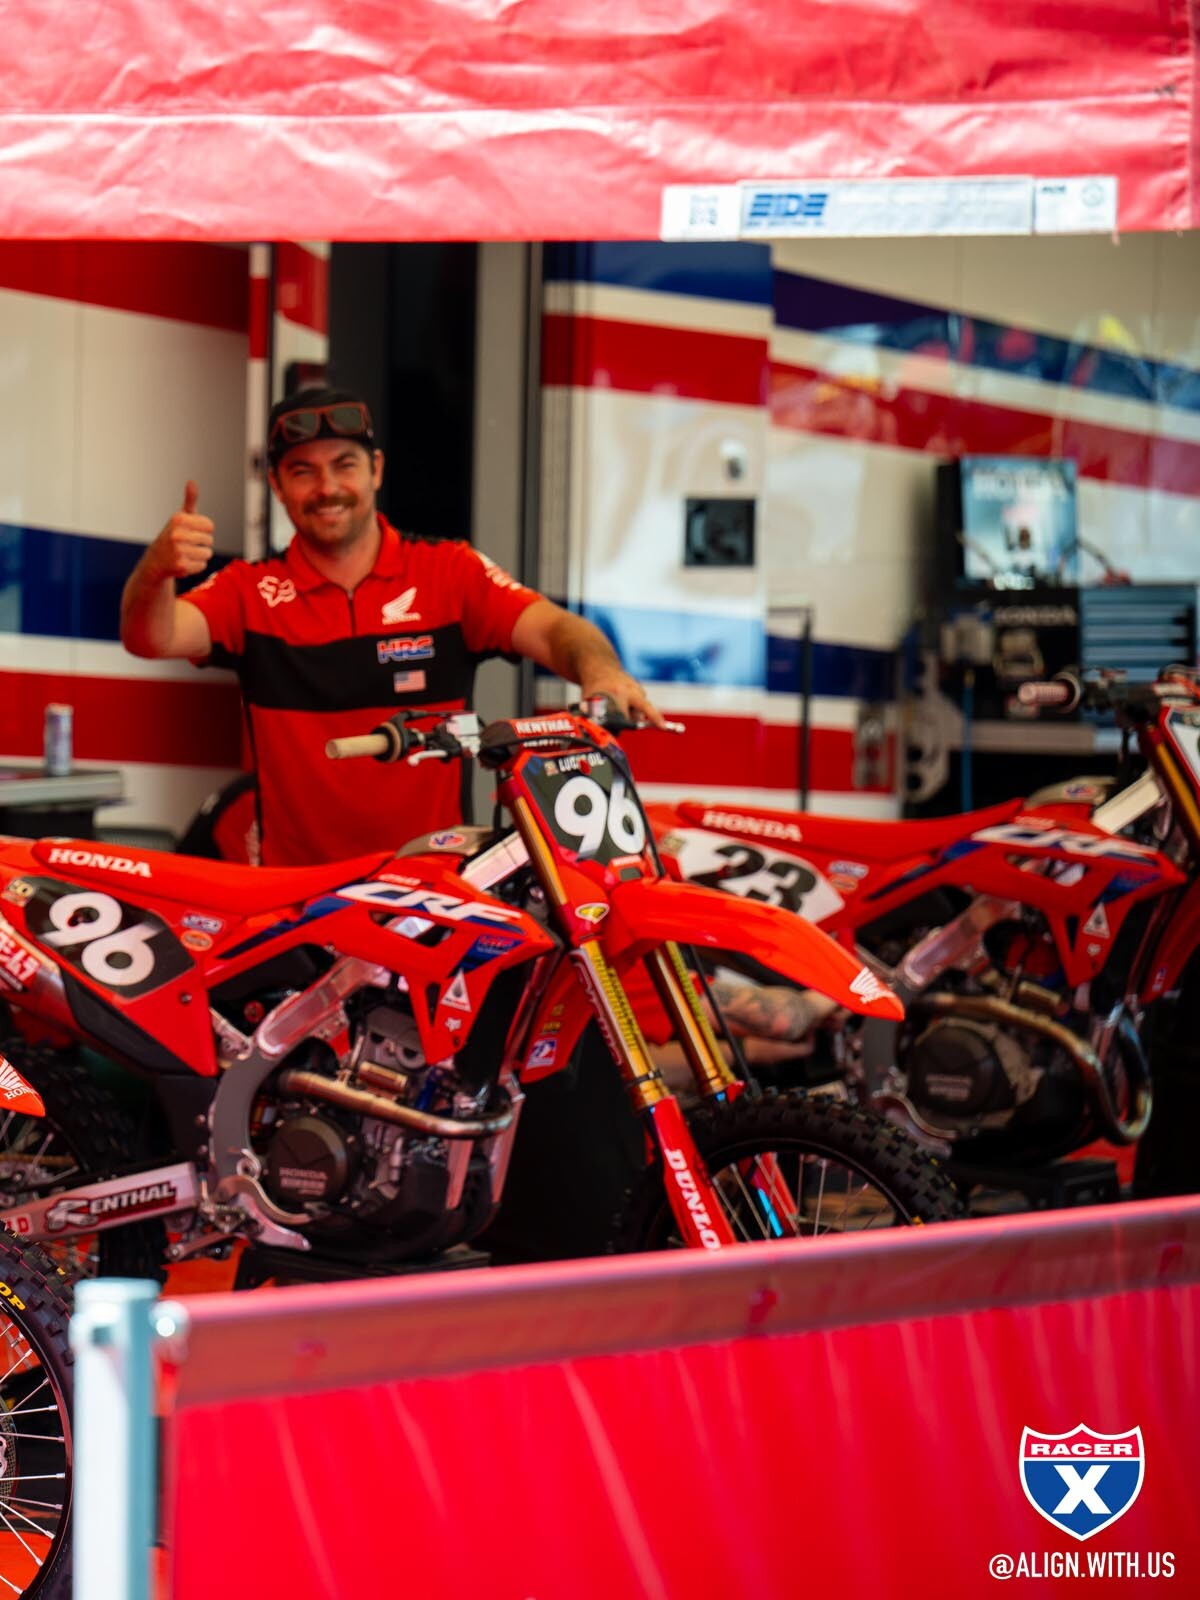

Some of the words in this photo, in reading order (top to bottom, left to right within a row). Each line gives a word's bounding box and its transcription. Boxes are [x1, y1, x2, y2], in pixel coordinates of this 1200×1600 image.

[377, 635, 435, 663] HRC
[515, 719, 574, 734] RENTHAL
[554, 775, 646, 862] 96
[702, 809, 804, 843] HONDA
[47, 847, 153, 879] HONDA
[688, 844, 818, 914] 23
[335, 881, 523, 922] CRF
[37, 890, 157, 987] 96
[47, 1184, 176, 1231] RENTHAL
[664, 1148, 721, 1250] DUNLO
